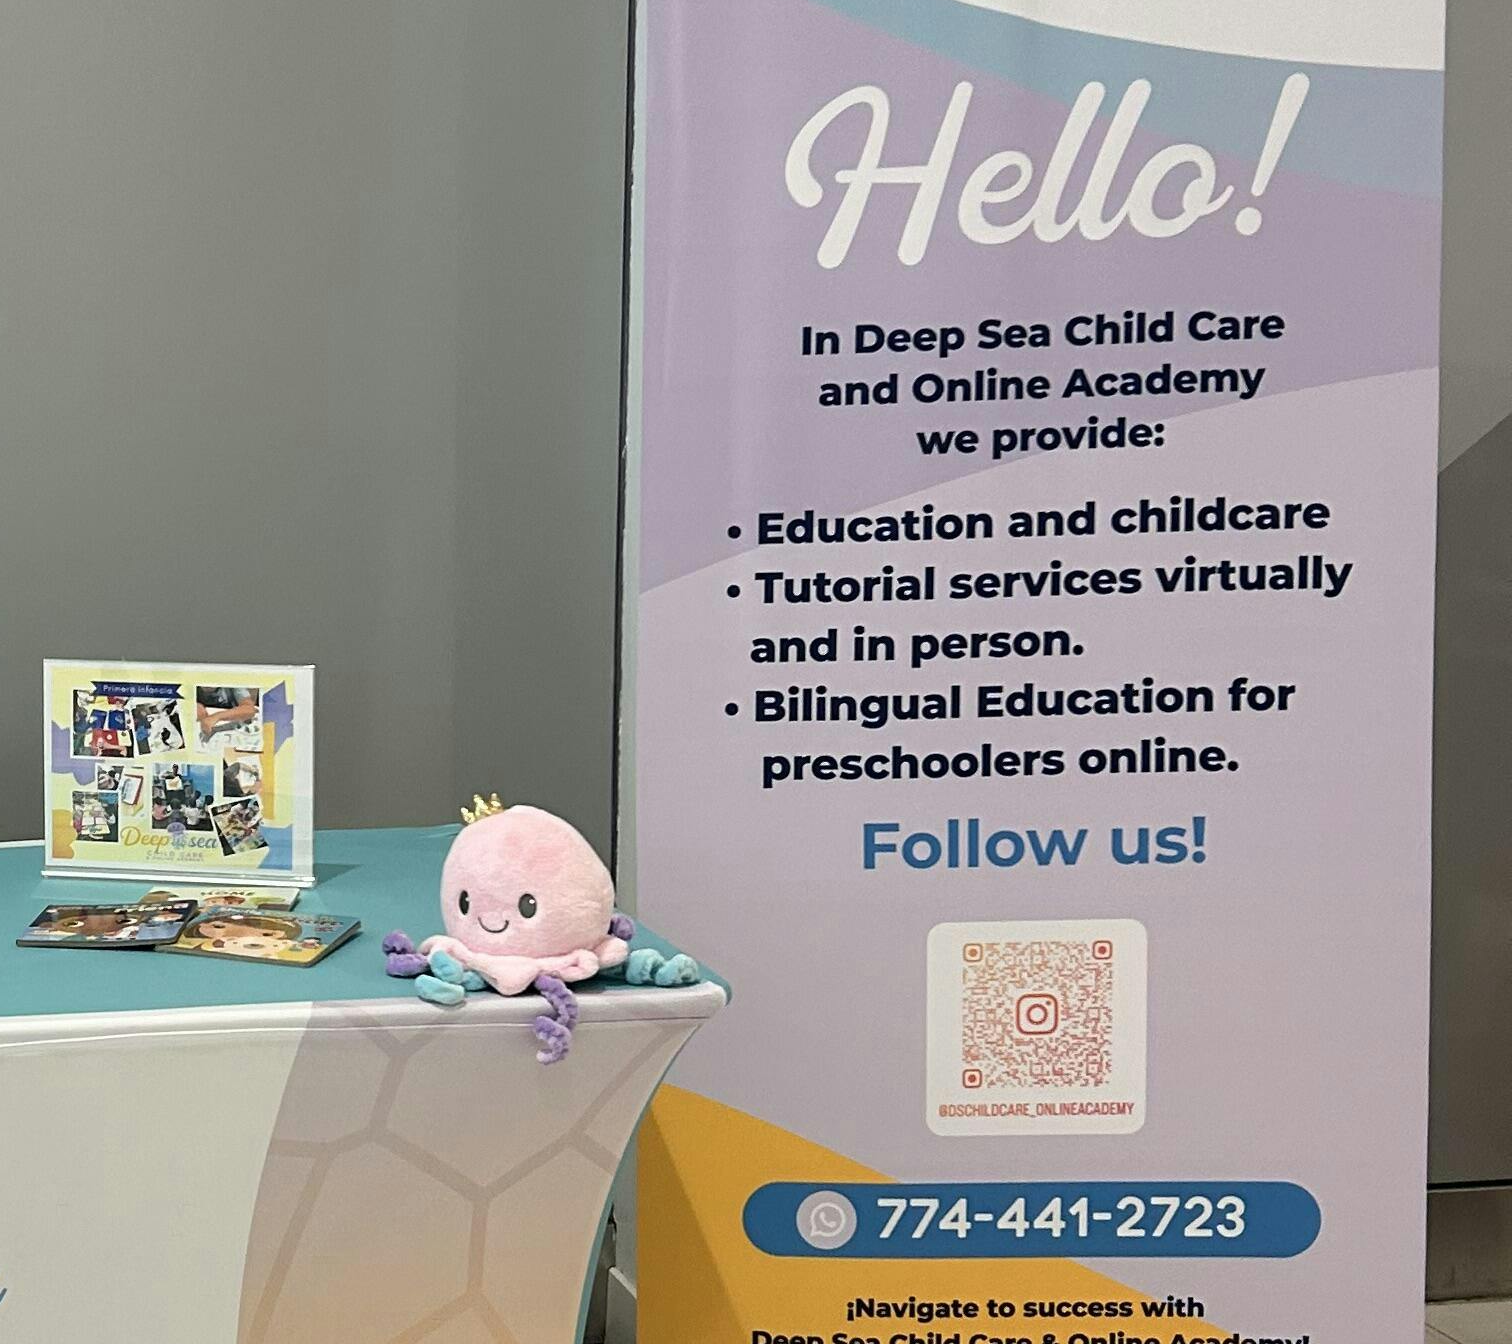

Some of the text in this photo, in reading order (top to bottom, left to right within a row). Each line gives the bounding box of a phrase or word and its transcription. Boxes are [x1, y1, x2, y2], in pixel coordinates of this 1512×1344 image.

[784, 72, 1310, 269] Hello!
[800, 310, 1285, 359] In Deep Sea Child Care
[818, 363, 1265, 406] and Online Academy
[917, 418, 1164, 459] we provide:
[757, 496, 1330, 545] Education and childcare
[755, 556, 1353, 604] Tutorial services virtually
[750, 625, 1085, 668] and in person.
[754, 678, 1296, 728] Bilingual Education for
[761, 737, 1239, 789] preschoolers online.
[121, 826, 217, 853] Deep sea
[861, 815, 1207, 869] Follow us!
[939, 1102, 1134, 1117] @DSCHILDCARE_ONLINEACADEMY
[877, 1195, 1245, 1241] 774-441-2723
[846, 1296, 1204, 1322] ¡Navigate to success with
